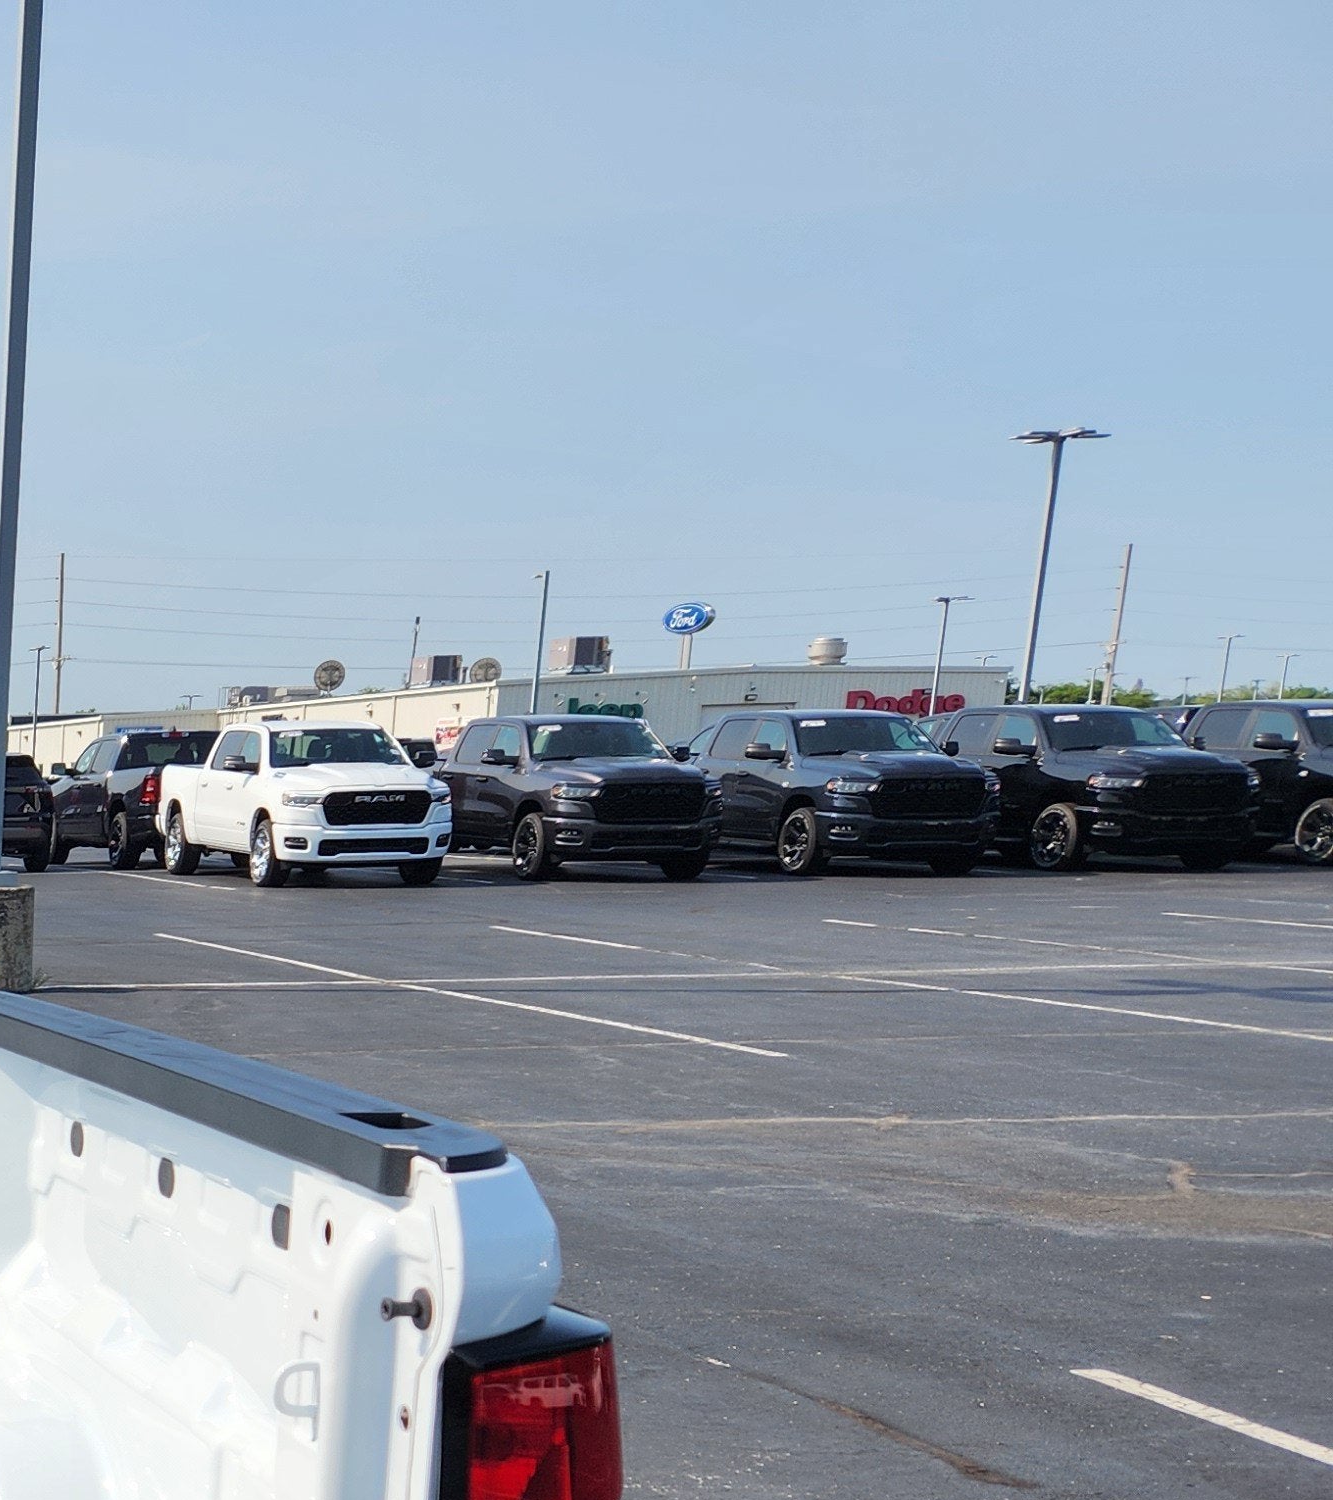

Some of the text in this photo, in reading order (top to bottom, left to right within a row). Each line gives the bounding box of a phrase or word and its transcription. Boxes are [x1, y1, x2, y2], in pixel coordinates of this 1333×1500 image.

[670, 608, 699, 628] Ford
[846, 688, 966, 718] Dodge
[354, 794, 406, 804] RAM
